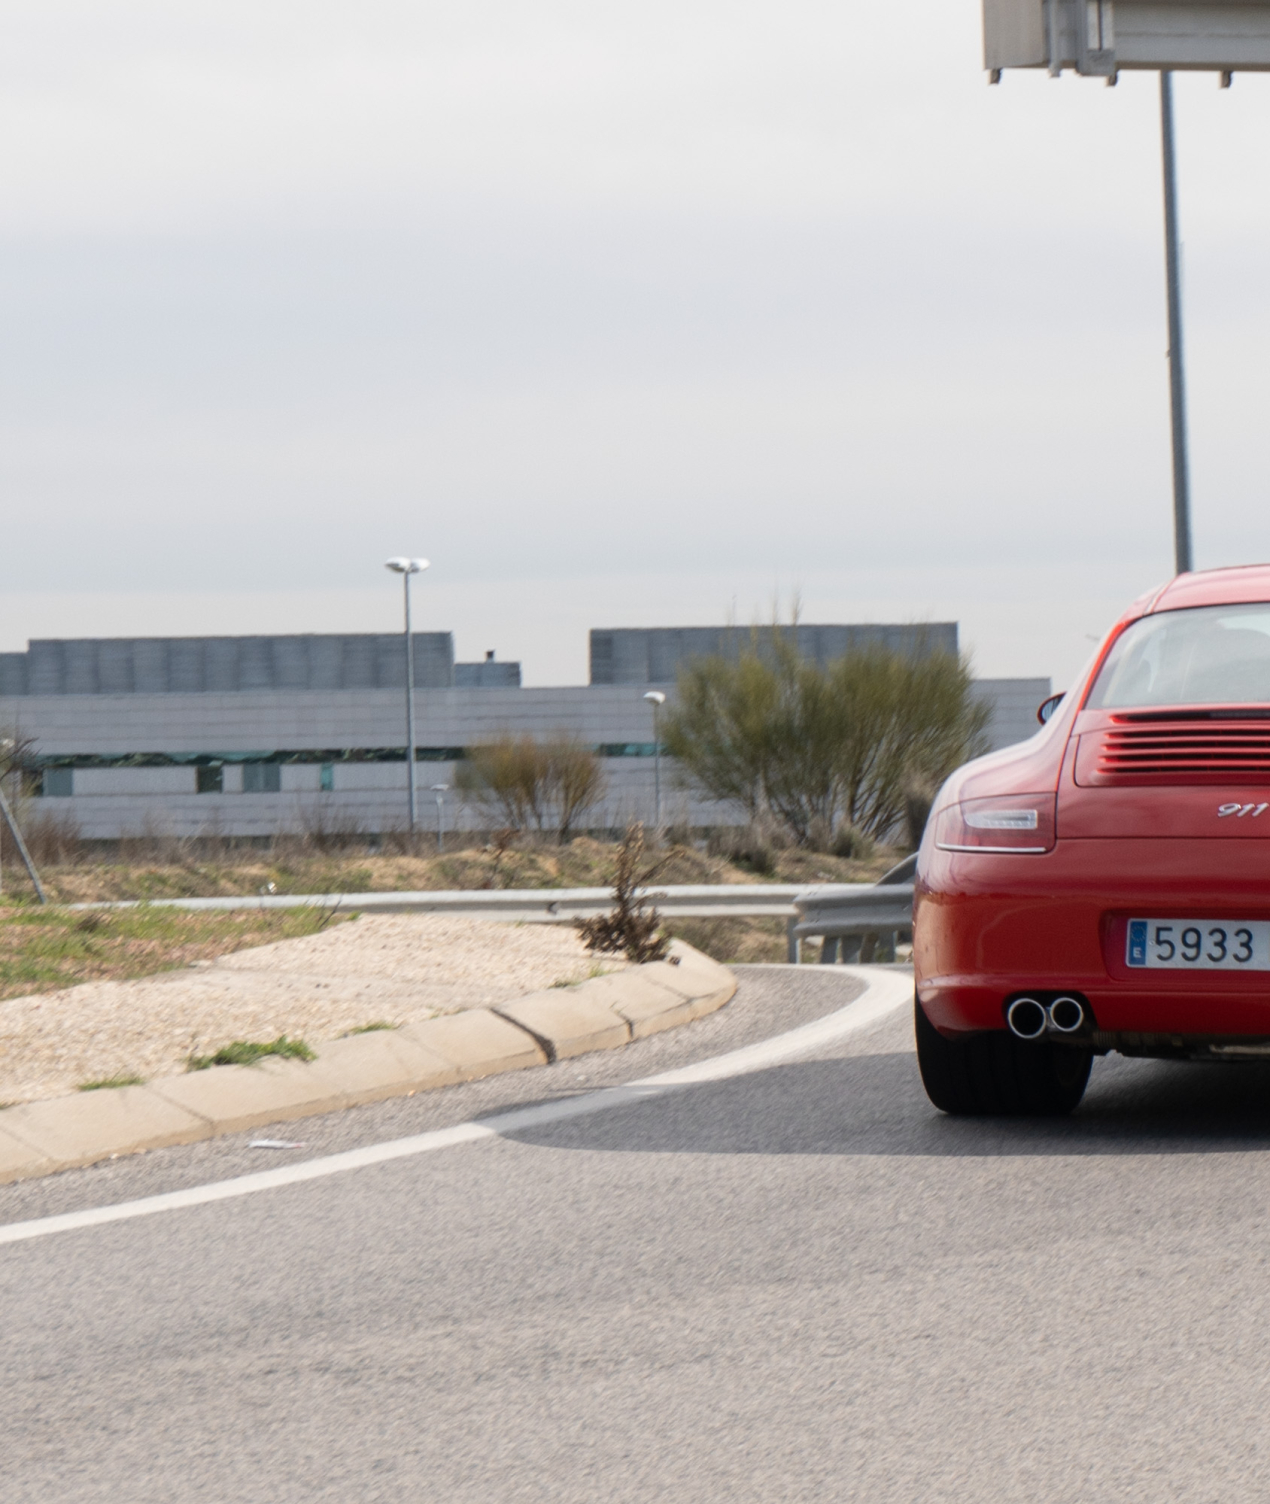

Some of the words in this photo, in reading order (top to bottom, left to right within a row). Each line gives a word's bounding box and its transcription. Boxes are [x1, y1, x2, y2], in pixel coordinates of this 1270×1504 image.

[1218, 802, 1269, 817] 911
[1133, 947, 1142, 958] E
[1155, 926, 1253, 963] 5933
